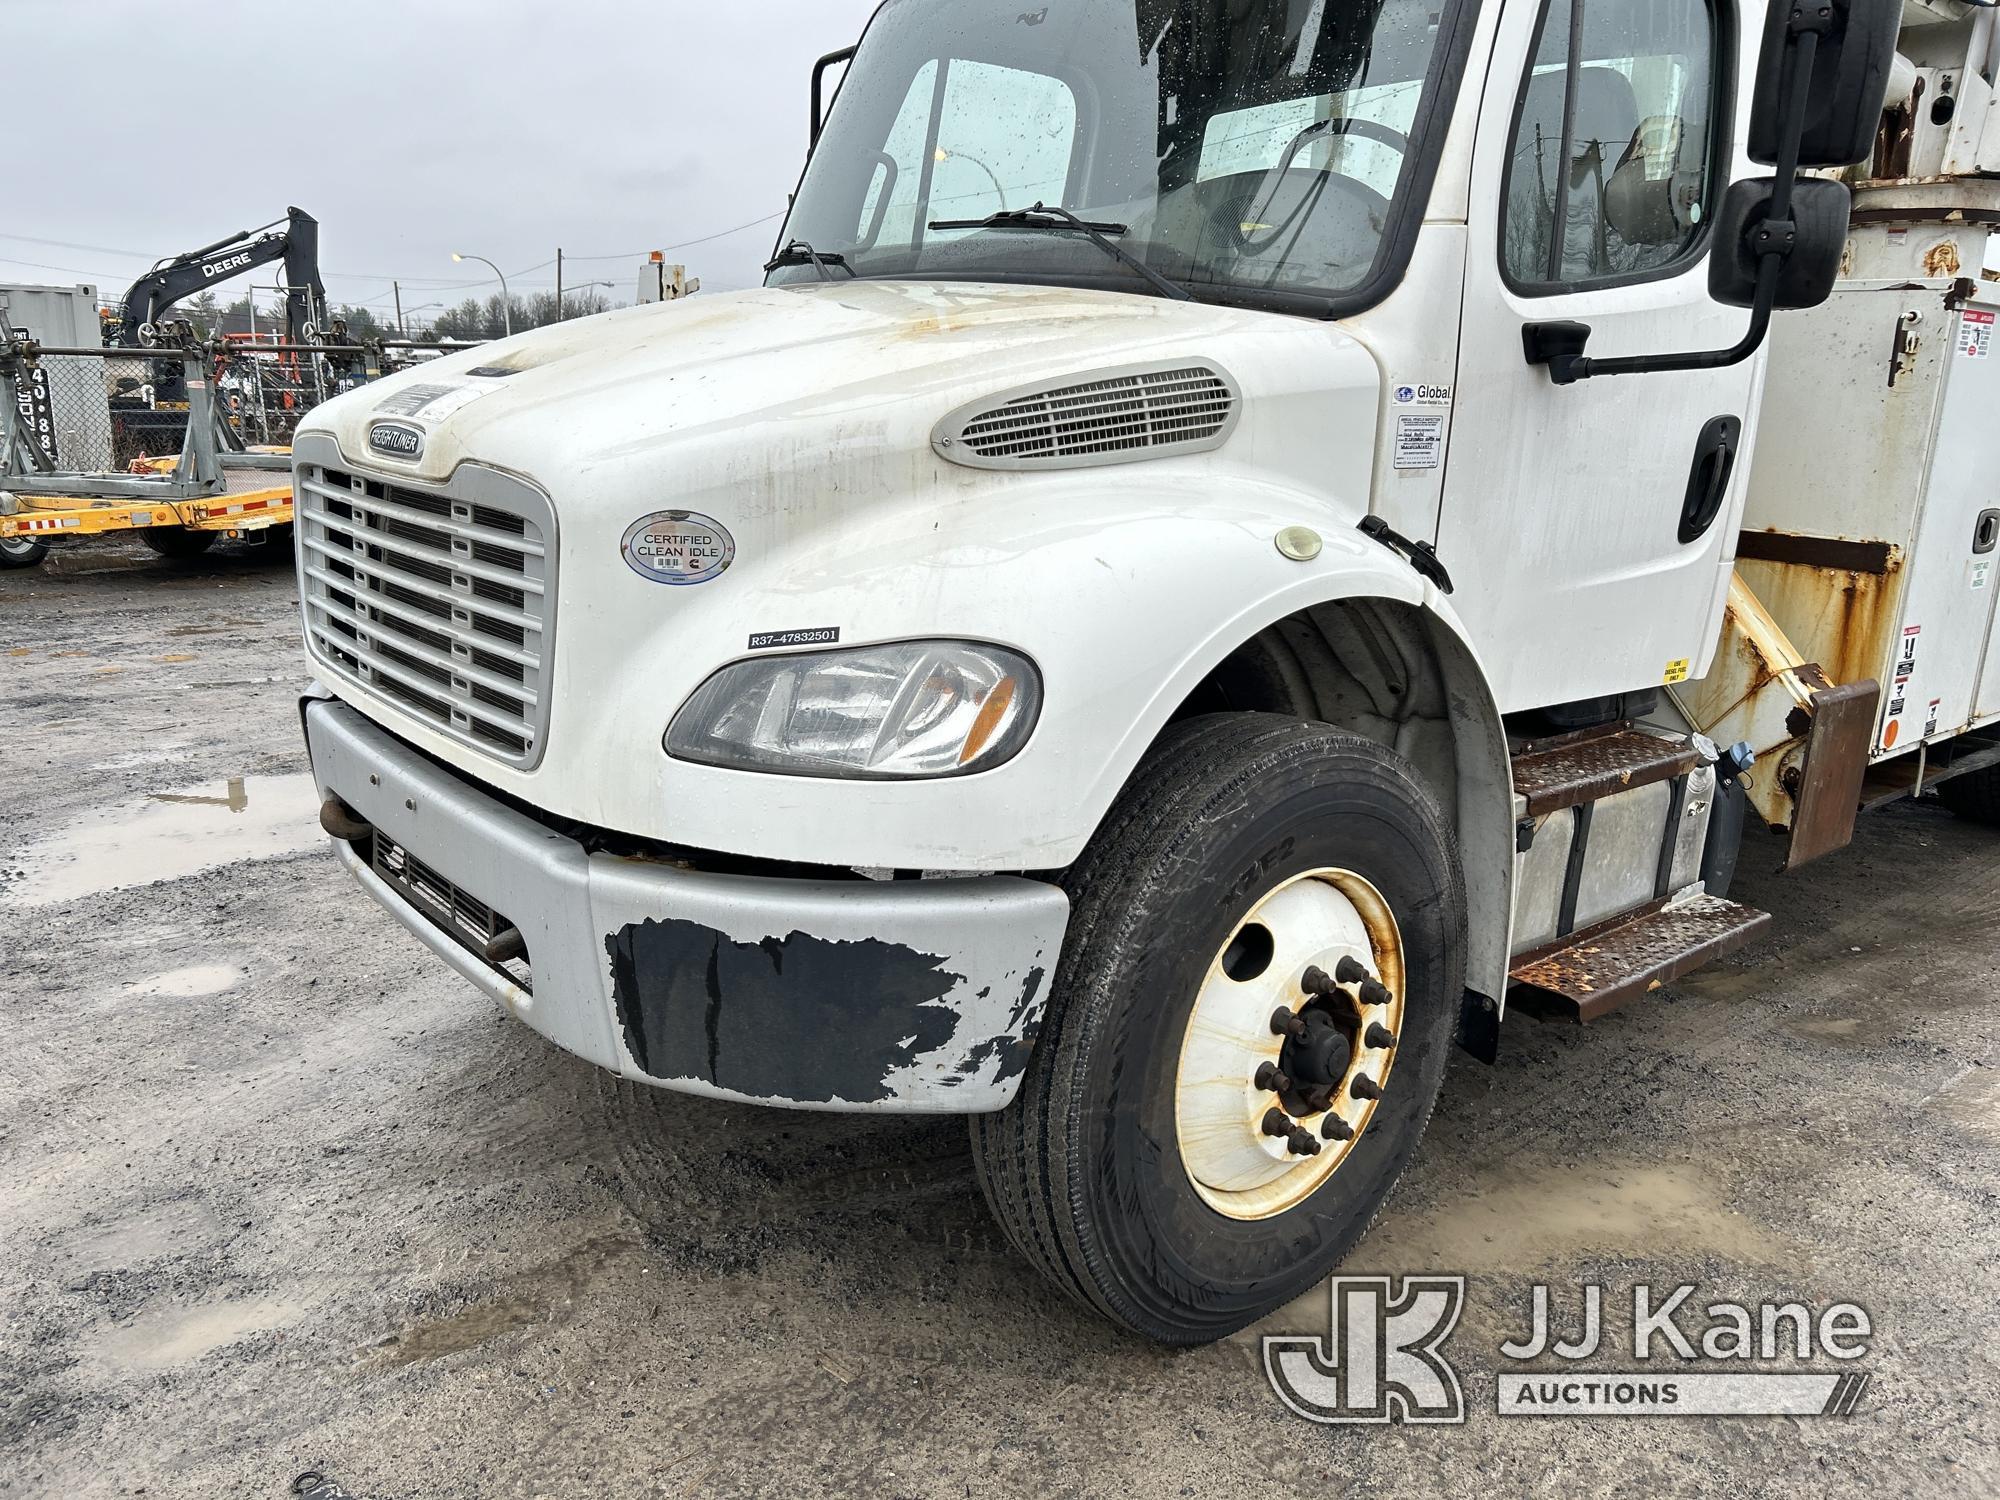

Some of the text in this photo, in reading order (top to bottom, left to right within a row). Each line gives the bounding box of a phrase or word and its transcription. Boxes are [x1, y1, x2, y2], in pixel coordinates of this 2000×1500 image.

[202, 252, 252, 277] DEERE
[1418, 385, 1451, 399] Global
[372, 430, 417, 451] FREIGHTLINER
[644, 534, 712, 545] CERTIFIED
[637, 546, 719, 557] CLEAN IDLE
[751, 630, 836, 646] R37-47832501
